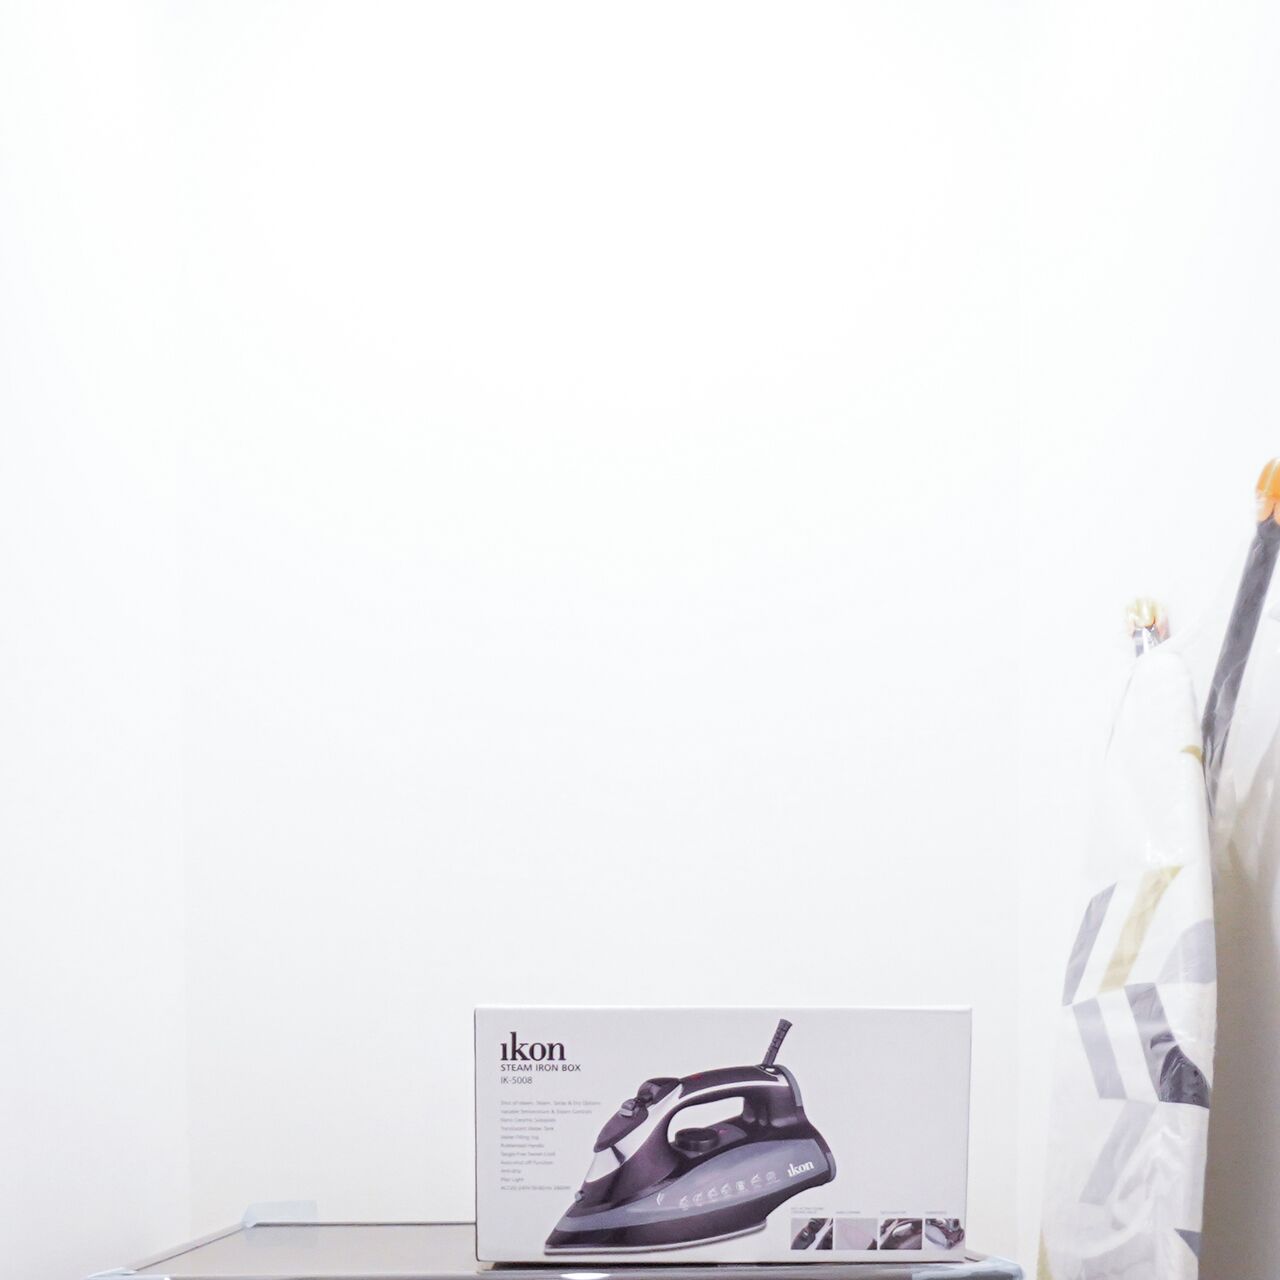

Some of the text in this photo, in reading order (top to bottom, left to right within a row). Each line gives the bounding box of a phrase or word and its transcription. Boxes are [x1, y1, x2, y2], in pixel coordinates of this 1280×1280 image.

[500, 1031, 566, 1061] ikon
[500, 1063, 581, 1072] STEAM IRON BOX
[787, 1161, 814, 1177] ikon
